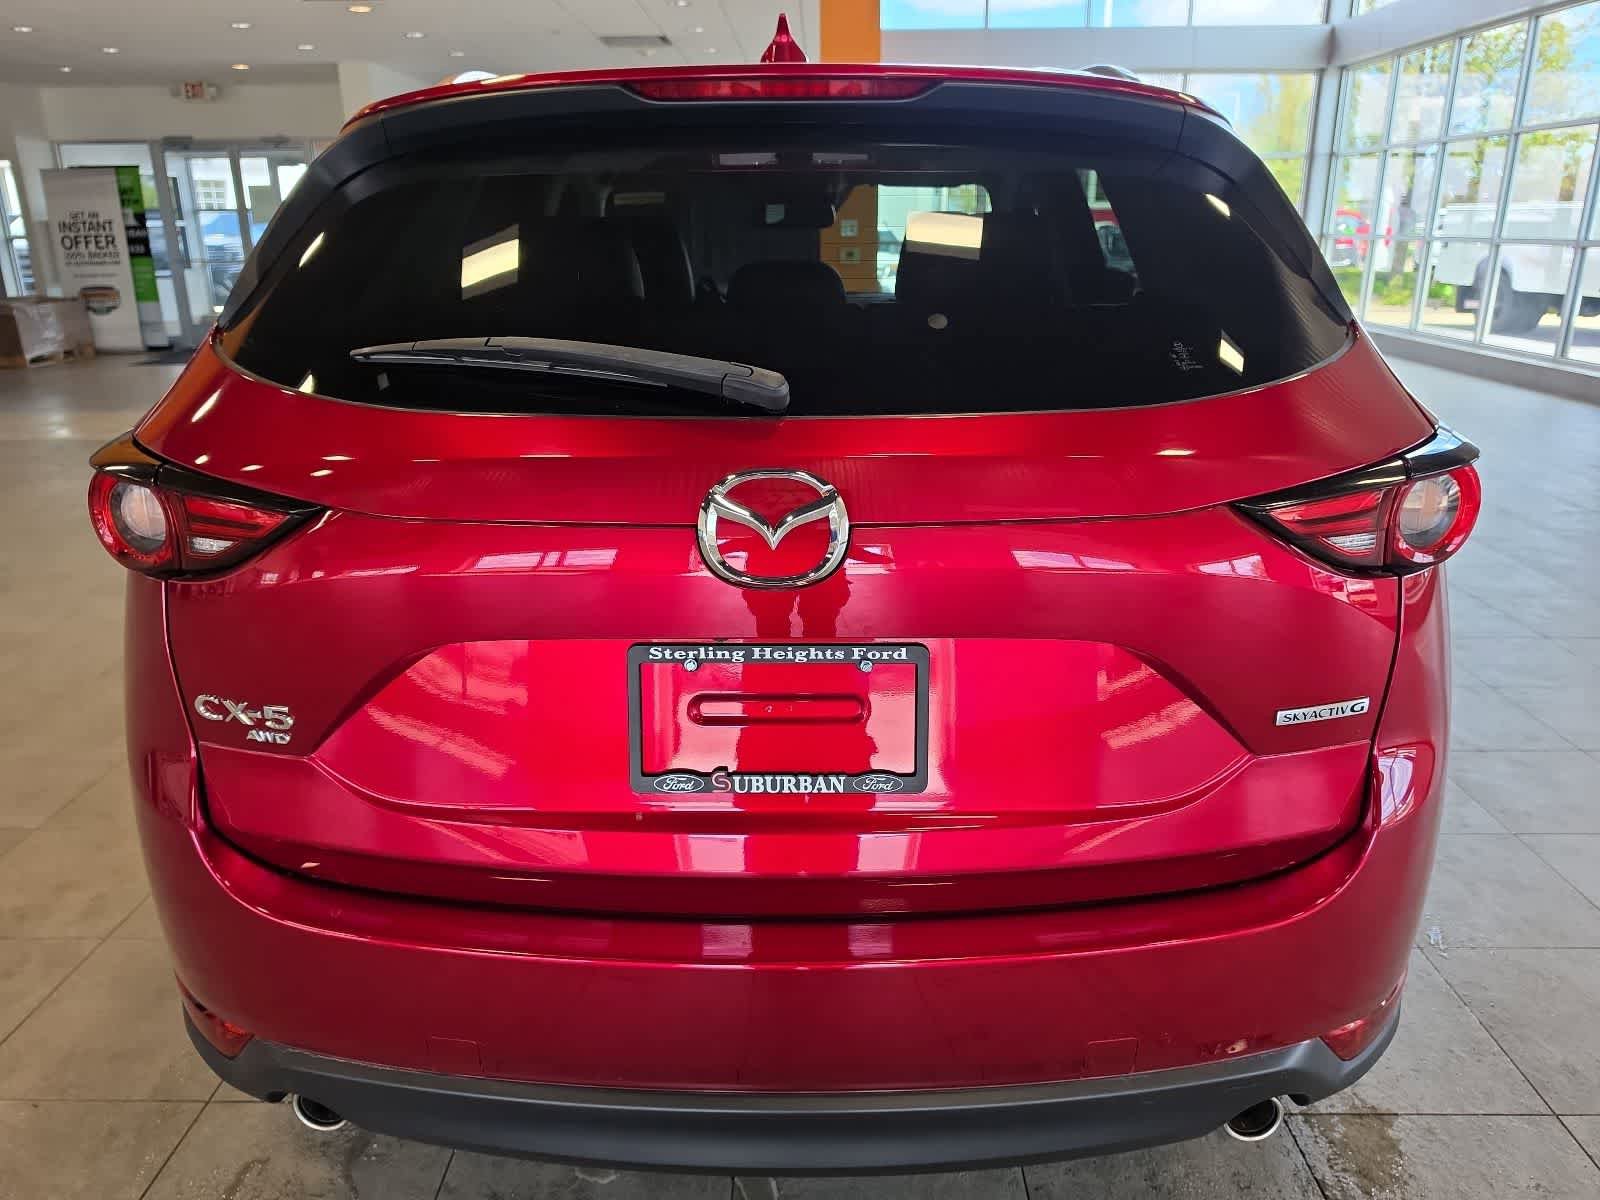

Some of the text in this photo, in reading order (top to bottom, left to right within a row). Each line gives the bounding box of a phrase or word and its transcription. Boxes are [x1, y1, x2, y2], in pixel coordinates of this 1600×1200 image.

[58, 221, 113, 233] INSTANT
[61, 234, 117, 250] OFFER
[649, 646, 908, 663] Sterling Heights Ford
[194, 693, 294, 730] CX-5
[246, 729, 292, 745] AWD
[660, 776, 697, 791] Ford
[711, 771, 846, 794] SUBURBAN
[859, 776, 896, 791] Ford
